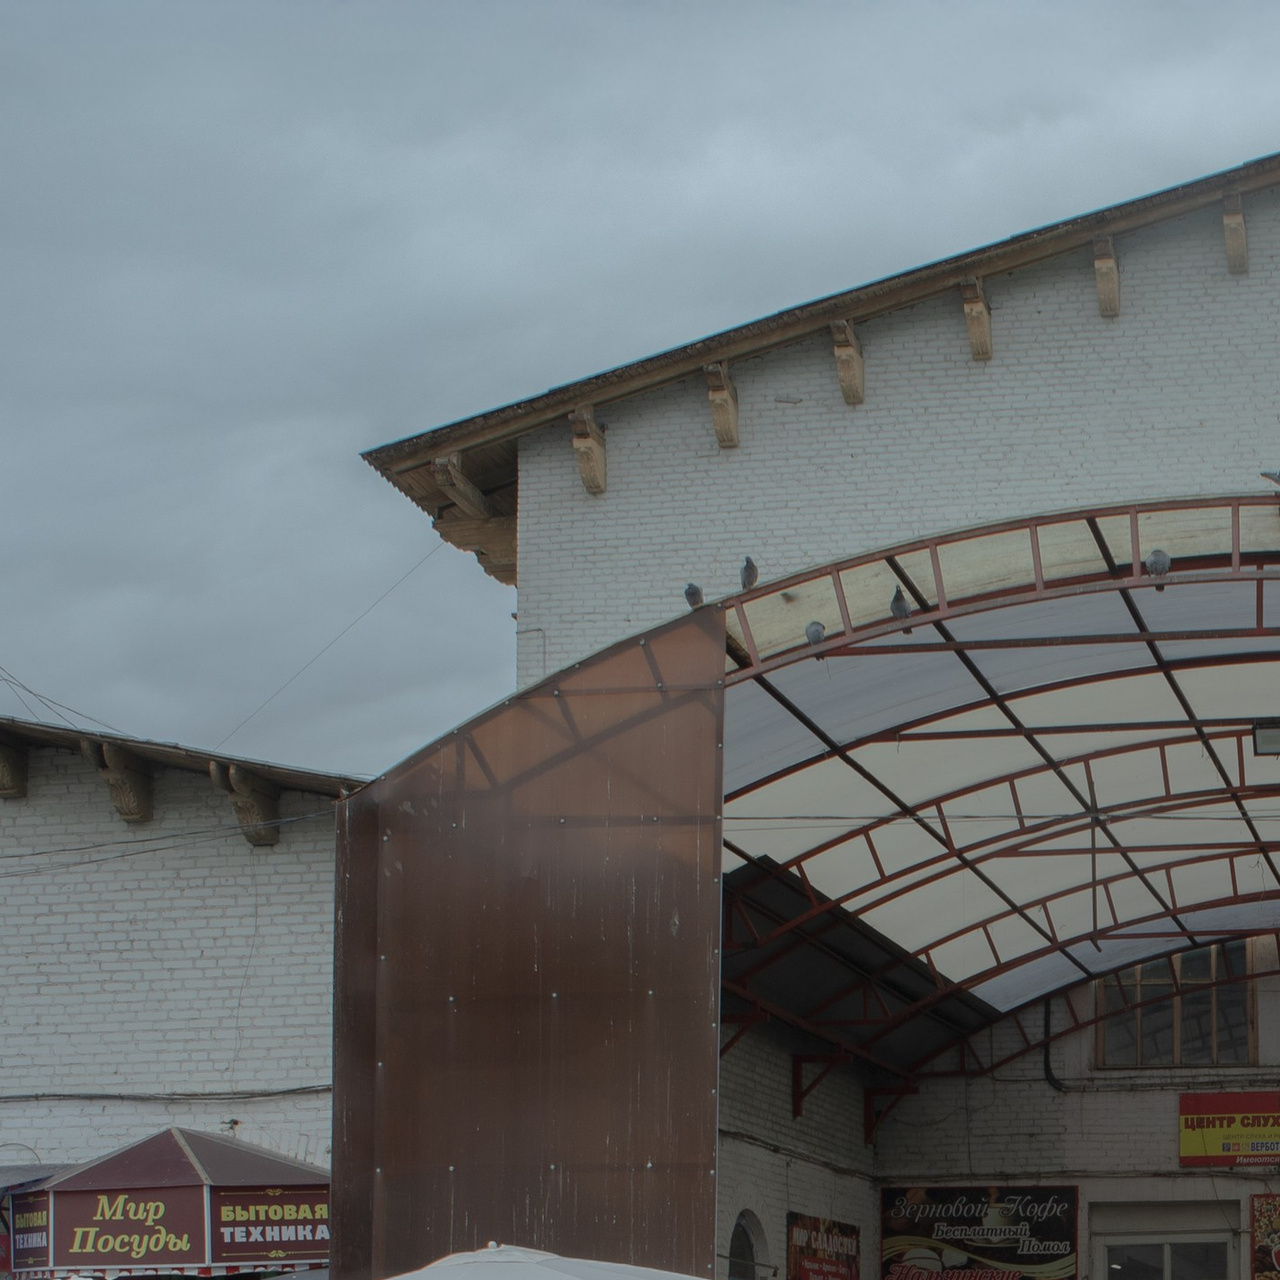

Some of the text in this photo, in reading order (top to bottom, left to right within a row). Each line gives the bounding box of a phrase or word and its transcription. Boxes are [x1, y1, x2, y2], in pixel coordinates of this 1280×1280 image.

[1184, 1116, 1235, 1131] ЦЕНТР
[1236, 1156, 1280, 1164] Имеются
[93, 1195, 165, 1226] Мир
[220, 1203, 328, 1222] БЫТОВАЯ
[891, 1195, 1068, 1225] Зерновой Кофе
[15, 1211, 47, 1229] БЫТОВАЯ
[220, 1224, 330, 1243] ТЕХНИКА
[932, 1223, 1030, 1240] Бесплатный
[15, 1232, 47, 1250] ТЕХНИКА
[69, 1226, 191, 1258] Посуды
[1017, 1238, 1070, 1254] Помол
